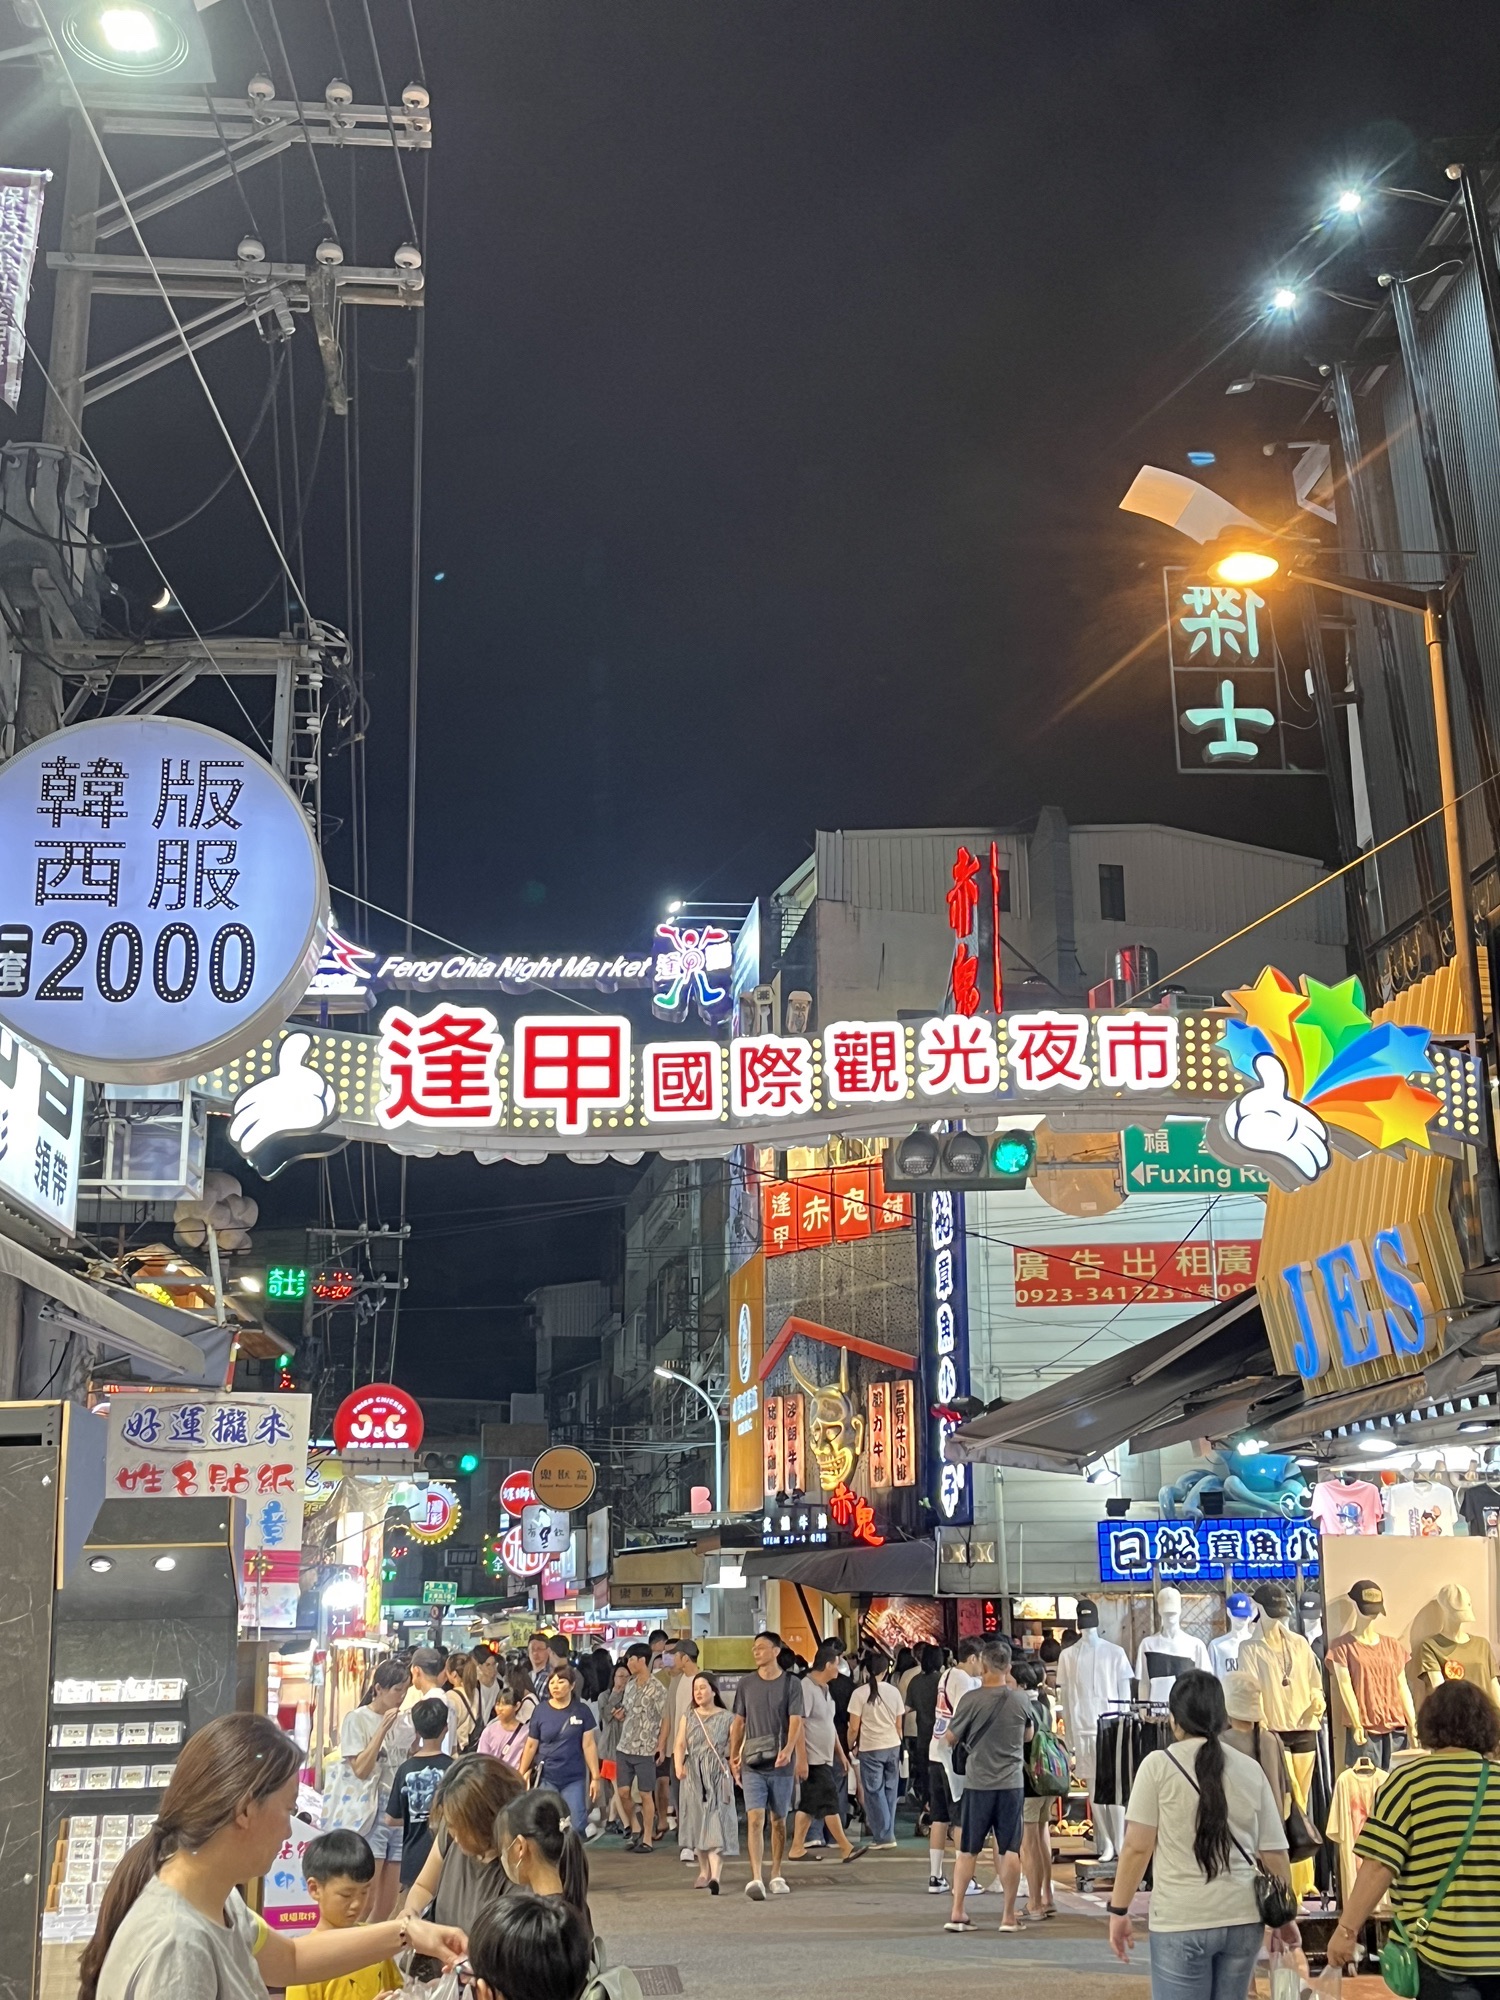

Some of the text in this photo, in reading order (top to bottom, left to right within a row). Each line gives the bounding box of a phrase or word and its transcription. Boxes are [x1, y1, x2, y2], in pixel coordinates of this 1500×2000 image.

[37, 756, 245, 829] 韓版
[34, 839, 240, 911] 西服
[35, 920, 256, 1003] 2000
[377, 956, 443, 982] Feng
[441, 956, 497, 979] Chia
[496, 956, 563, 983] Night
[559, 955, 653, 979] Market
[385, 1012, 1169, 1125] 逢甲國際觀光夜市
[34, 1136, 68, 1206] 領帶
[1145, 1164, 1232, 1188] Fuxing
[771, 1192, 791, 1249] 逢甲
[803, 1188, 868, 1231] 赤鬼
[1015, 1246, 1212, 1282] 廣告出租
[1016, 1285, 1175, 1303] 0923-341323
[1282, 1225, 1427, 1380] JES
[122, 1406, 291, 1445] 好運攏來
[350, 1414, 408, 1440] J&G
[115, 1460, 297, 1497] 姓名貼紙
[830, 1482, 884, 1546] 赤鬼
